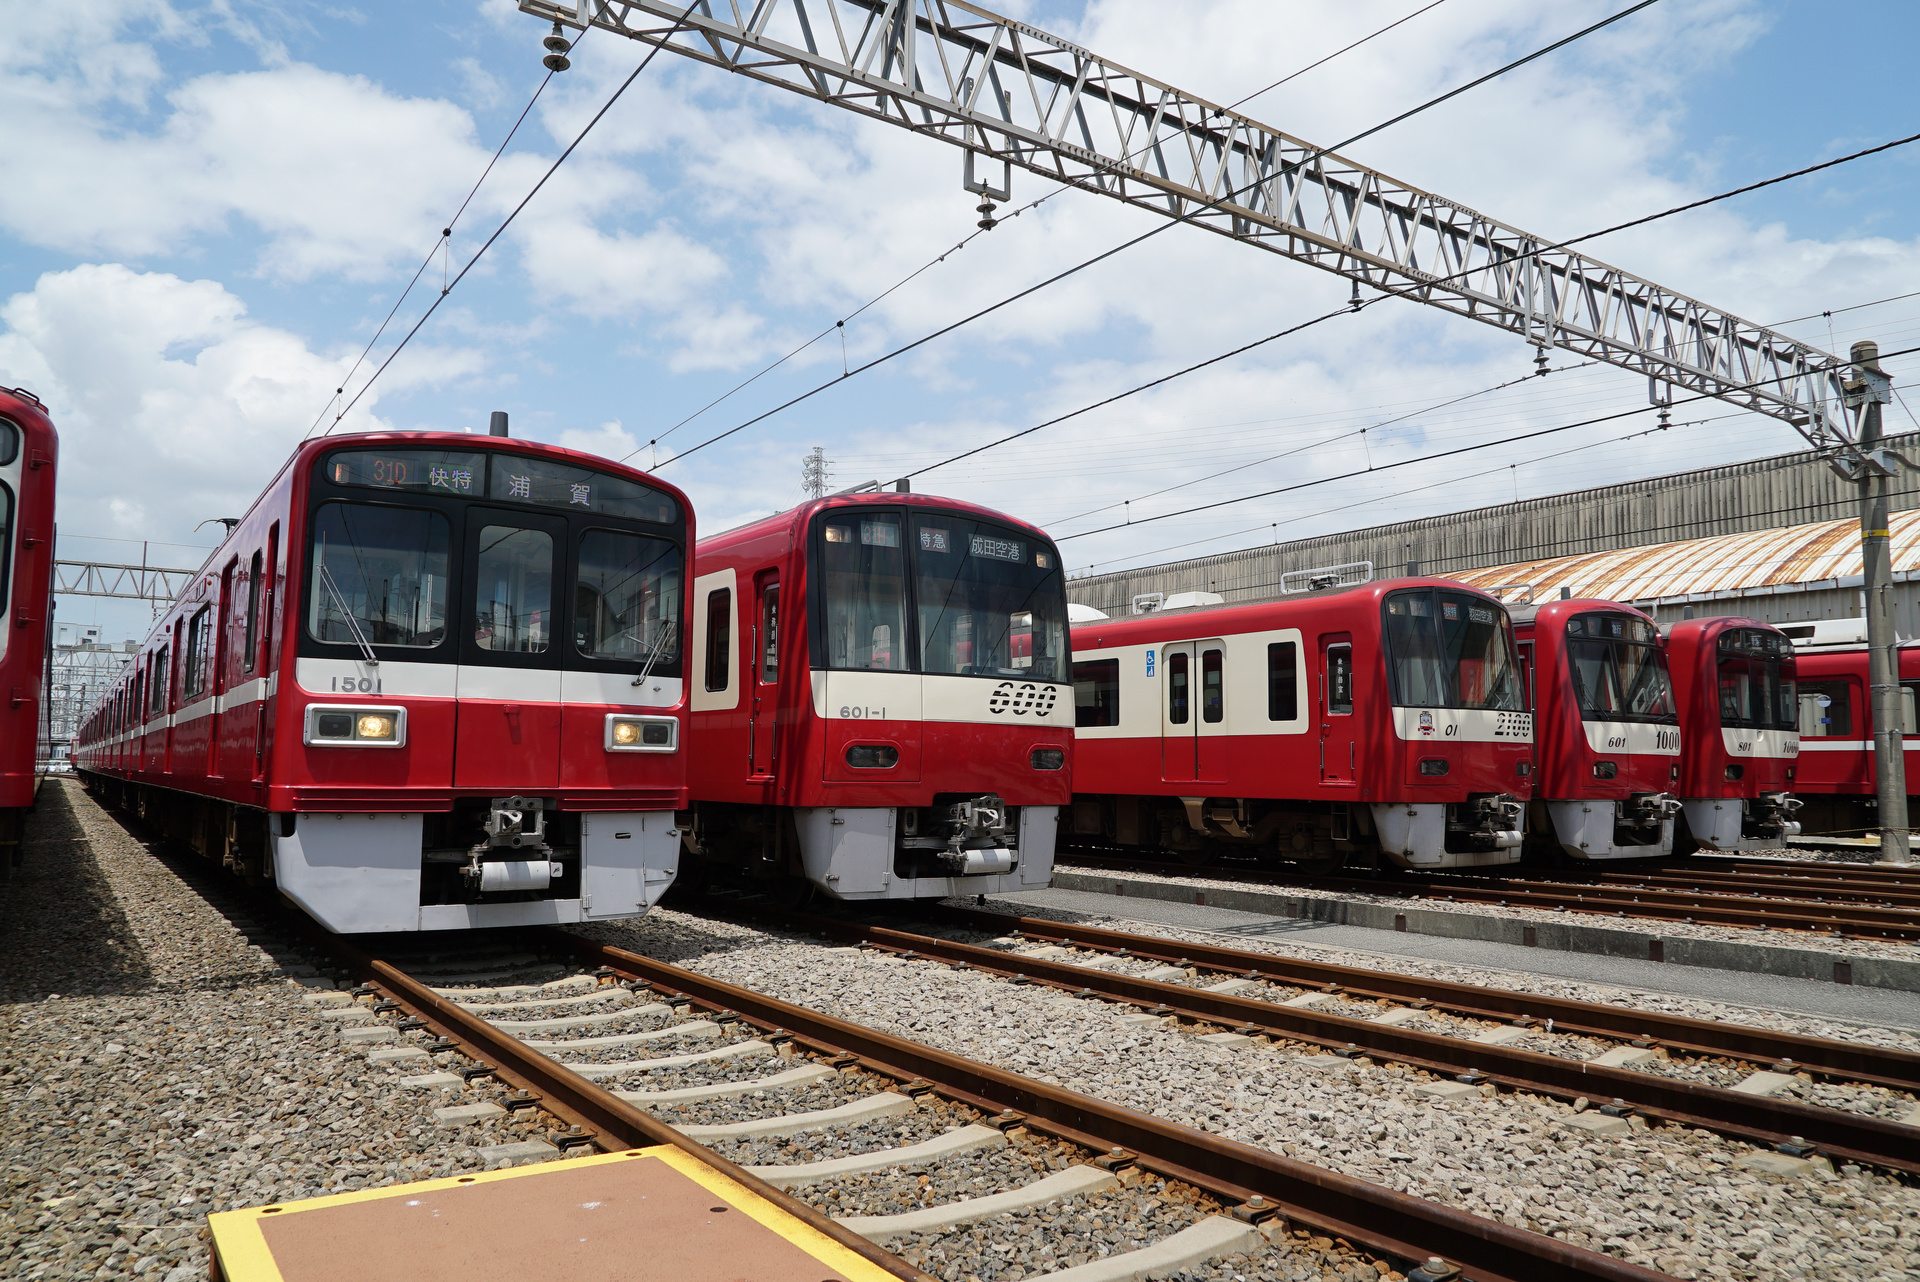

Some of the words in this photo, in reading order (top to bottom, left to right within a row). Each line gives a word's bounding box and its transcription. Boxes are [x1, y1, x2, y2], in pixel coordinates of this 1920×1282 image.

[373, 460, 407, 483] 31D
[429, 467, 472, 489] 快特
[920, 531, 946, 549] 特急
[971, 536, 1020, 561] 成田空港
[331, 676, 382, 693] 1501
[989, 681, 1057, 717] 600
[839, 705, 886, 719] 601-1
[1445, 724, 1458, 736] 01
[1494, 712, 1531, 737] 2100
[1608, 737, 1626, 748] 601
[1656, 730, 1680, 750] 1000
[1737, 741, 1752, 752] 801
[1783, 740, 1799, 754] 1000
